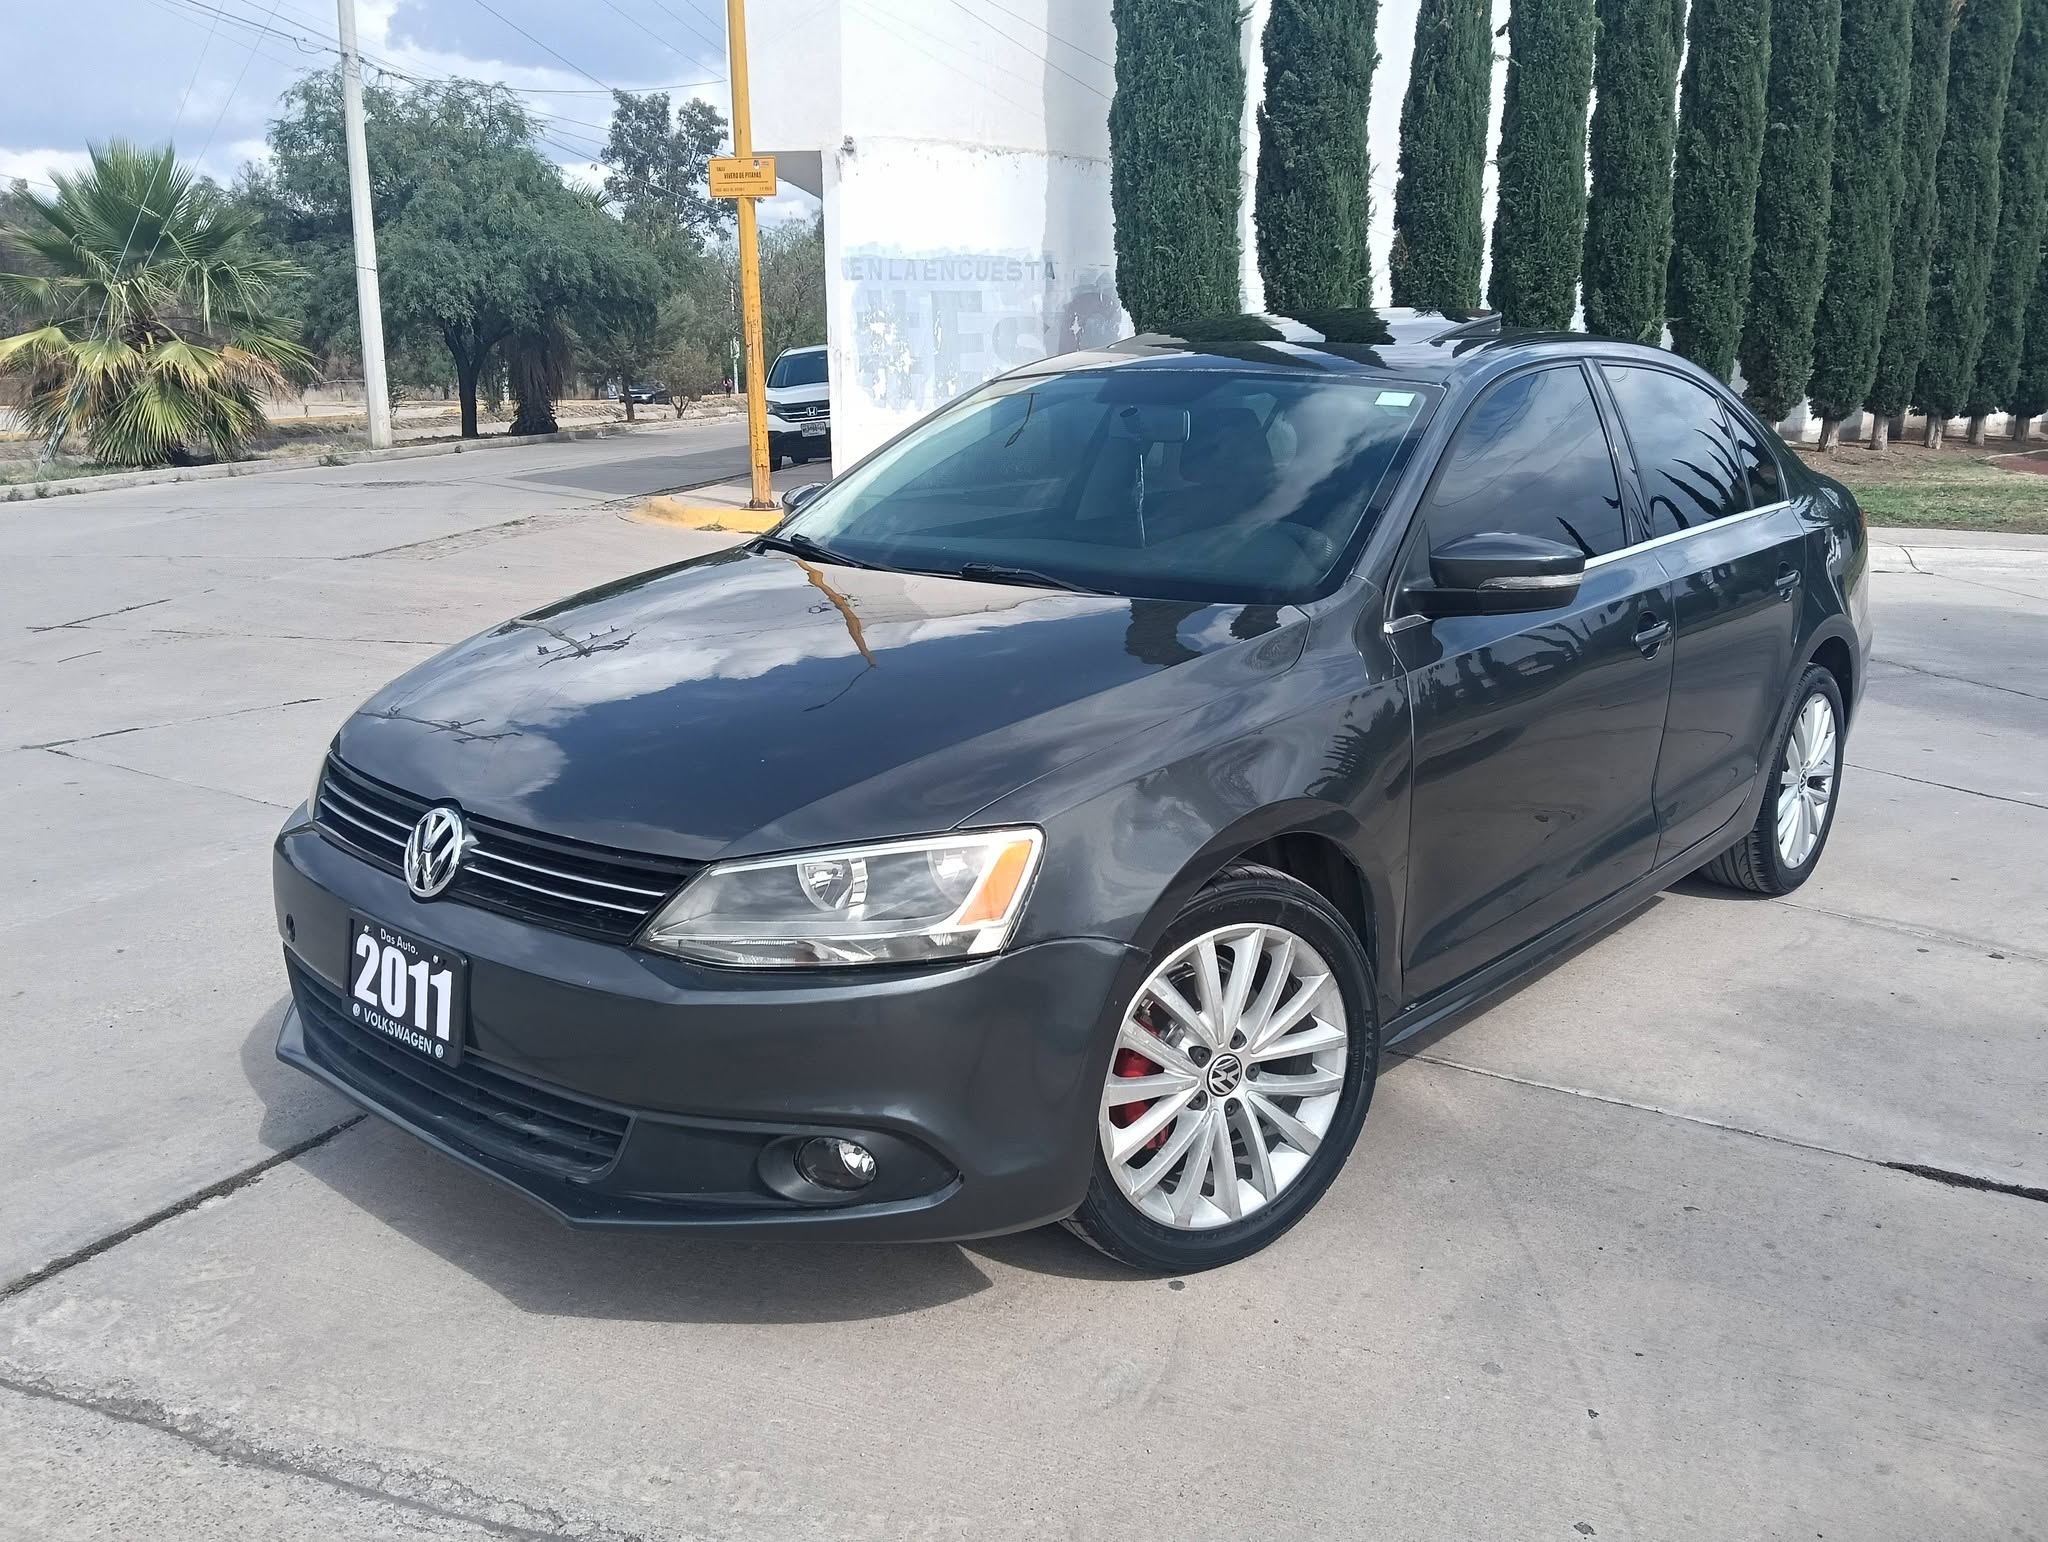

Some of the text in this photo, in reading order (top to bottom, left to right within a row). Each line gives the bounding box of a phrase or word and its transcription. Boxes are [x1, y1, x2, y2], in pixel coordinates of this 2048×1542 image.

[923, 258, 1057, 280] ENCUESTA
[380, 927, 419, 955] Das Auto.
[354, 933, 453, 1042] 2011
[363, 1007, 433, 1055] VOLKSWAGEN
